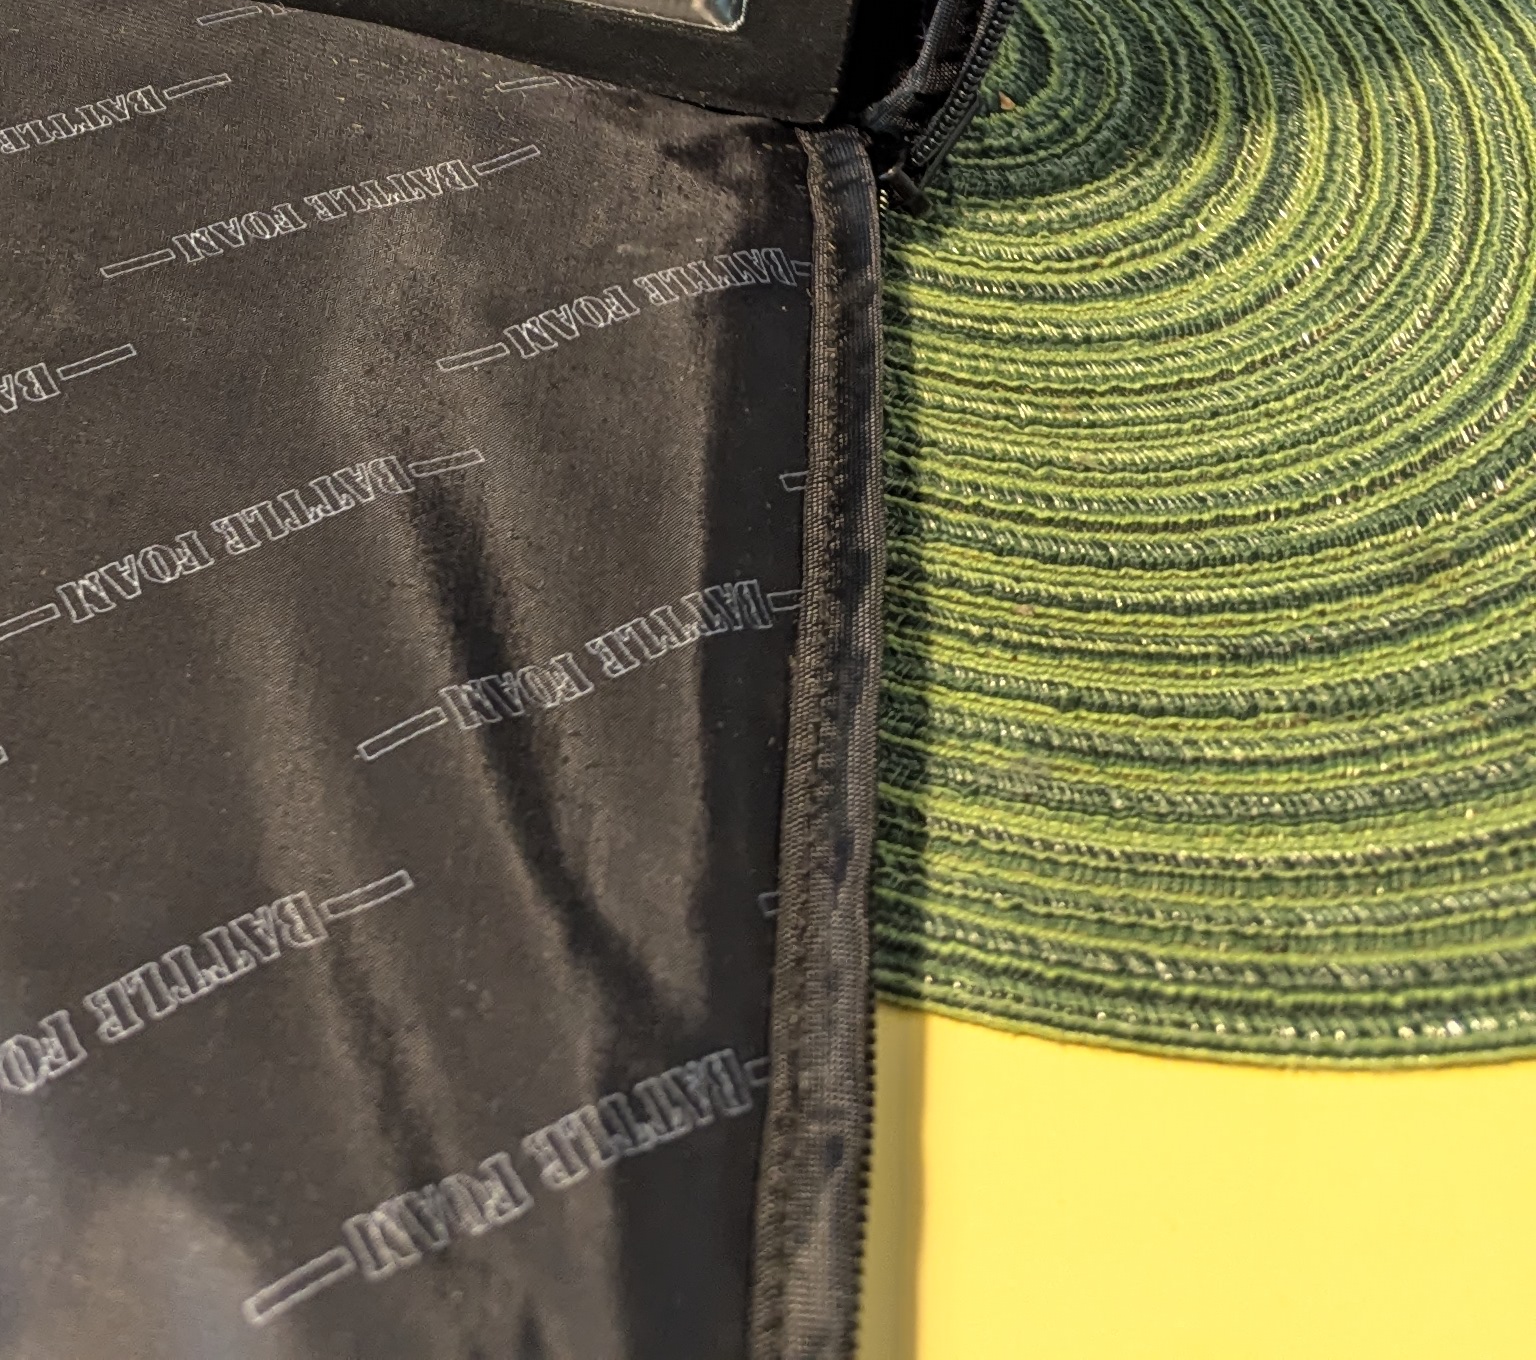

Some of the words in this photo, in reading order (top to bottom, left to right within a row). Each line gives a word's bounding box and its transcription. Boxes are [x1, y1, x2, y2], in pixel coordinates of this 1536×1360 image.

[171, 202, 307, 263] FOAM
[304, 159, 478, 222] BATTLE
[503, 285, 641, 359] FOAM
[633, 247, 797, 305] BATTLE
[210, 455, 416, 554] BATTLE
[55, 530, 215, 624] FOAM
[585, 579, 774, 678] BATTLE
[438, 652, 595, 730] FOAM
[83, 890, 328, 1044] BATTLE
[521, 1048, 753, 1191] BATTLE
[342, 1151, 535, 1281] FOAM
